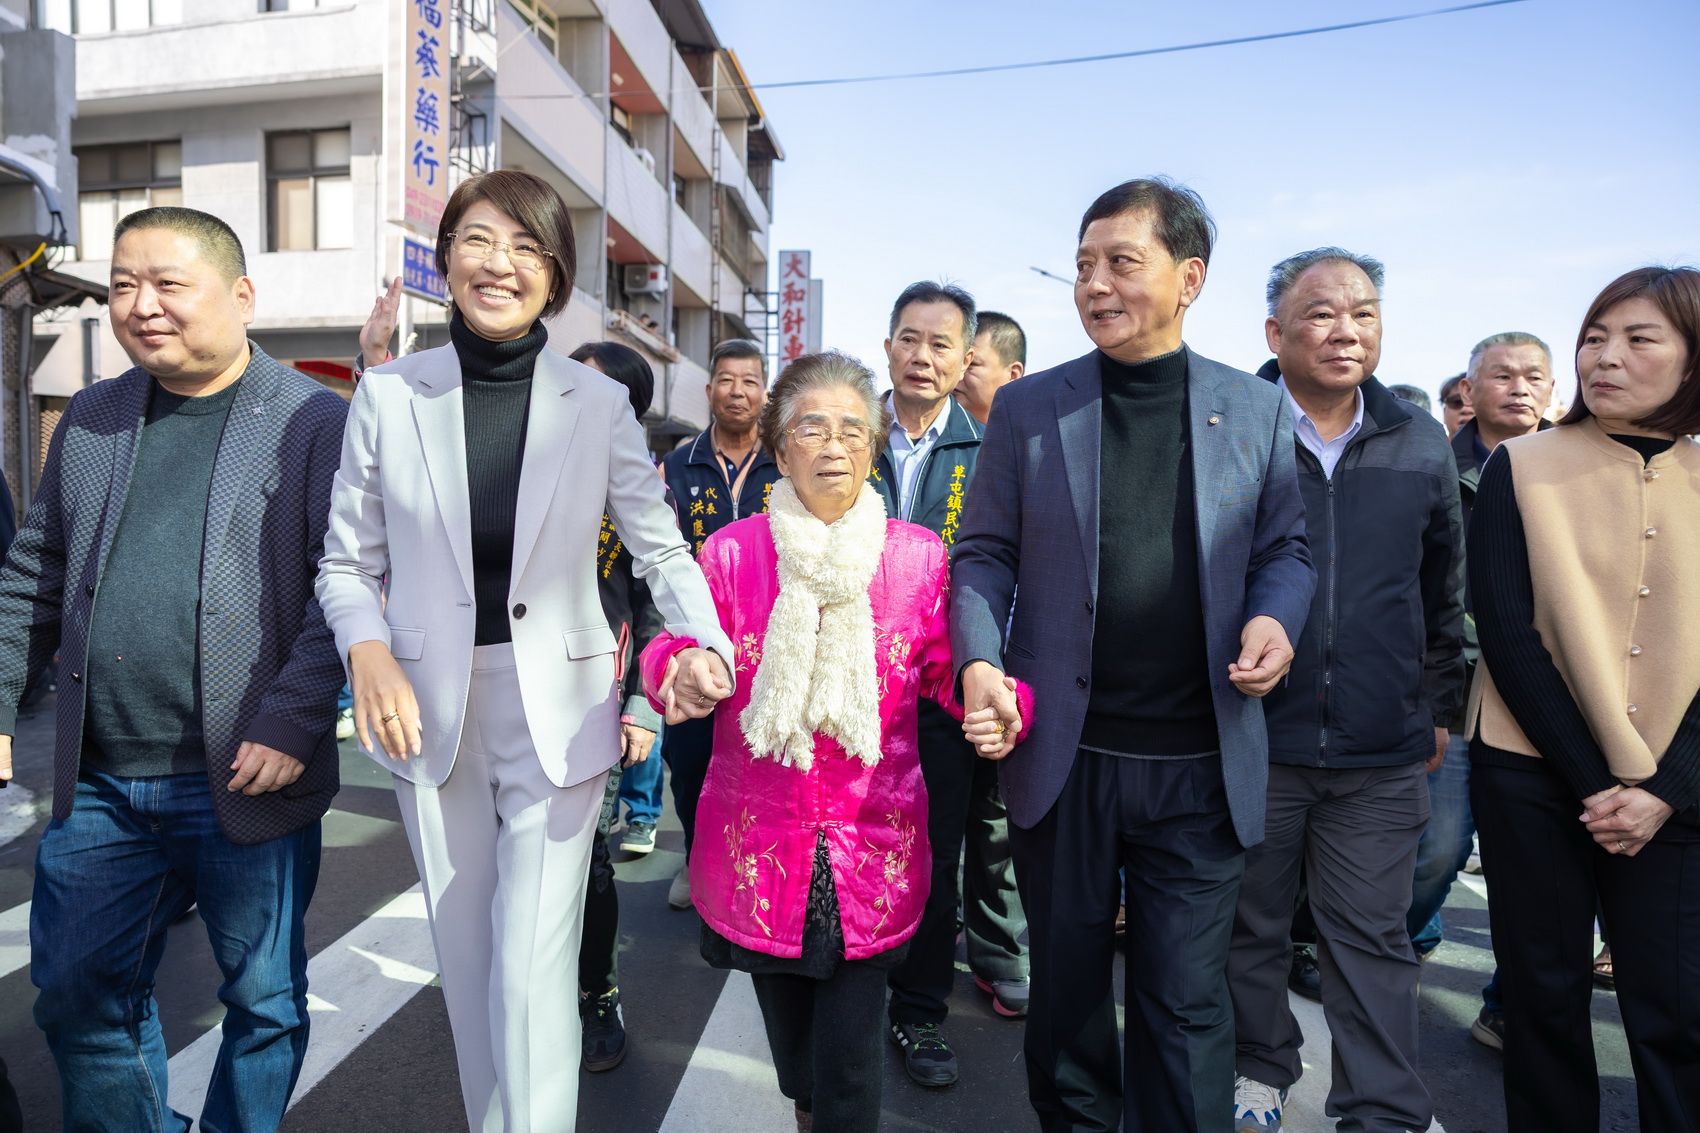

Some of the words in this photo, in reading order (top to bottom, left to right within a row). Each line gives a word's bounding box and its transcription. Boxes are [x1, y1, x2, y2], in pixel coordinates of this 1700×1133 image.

[782, 253, 806, 361] 大和針車
[705, 487, 718, 515] 代表
[941, 465, 966, 560] 草屯鎮民代
